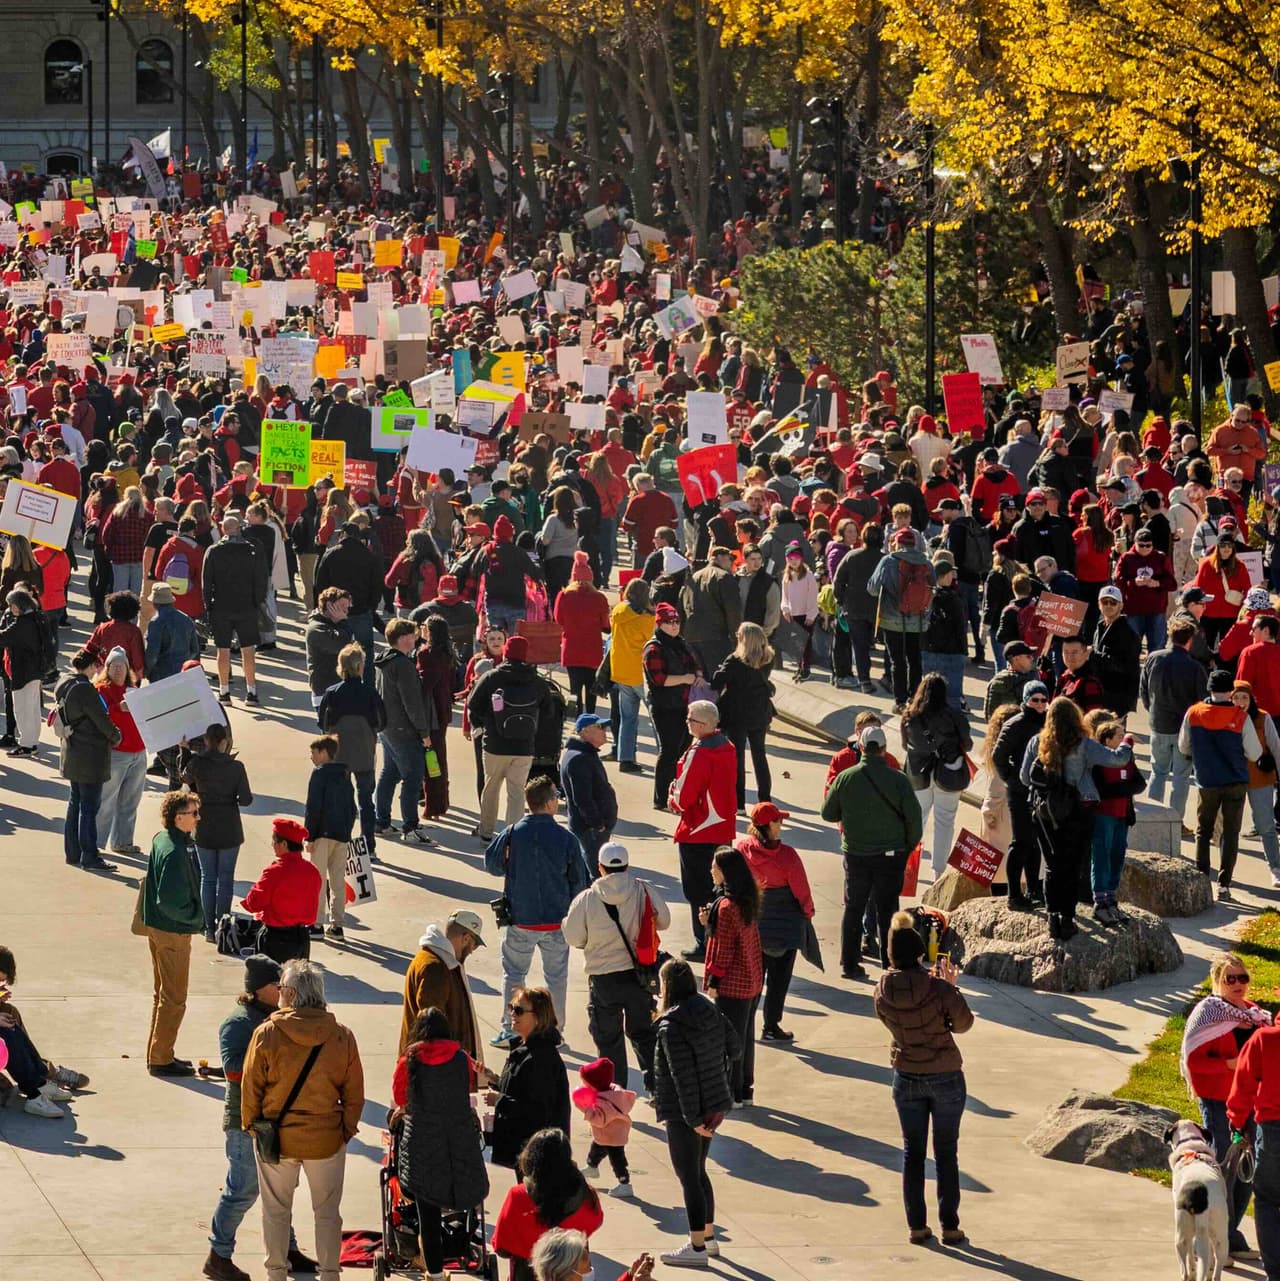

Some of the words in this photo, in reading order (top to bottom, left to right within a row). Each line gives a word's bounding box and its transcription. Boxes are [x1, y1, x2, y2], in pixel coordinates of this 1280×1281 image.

[275, 423, 298, 432] HEY!
[271, 447, 306, 458] FACTS
[311, 452, 338, 463] REAL
[265, 462, 306, 472] FICTION
[965, 836, 996, 858] EDUCATION
[960, 859, 975, 872] FOR
[974, 866, 994, 880] FIGHT
[356, 873, 371, 899] I
